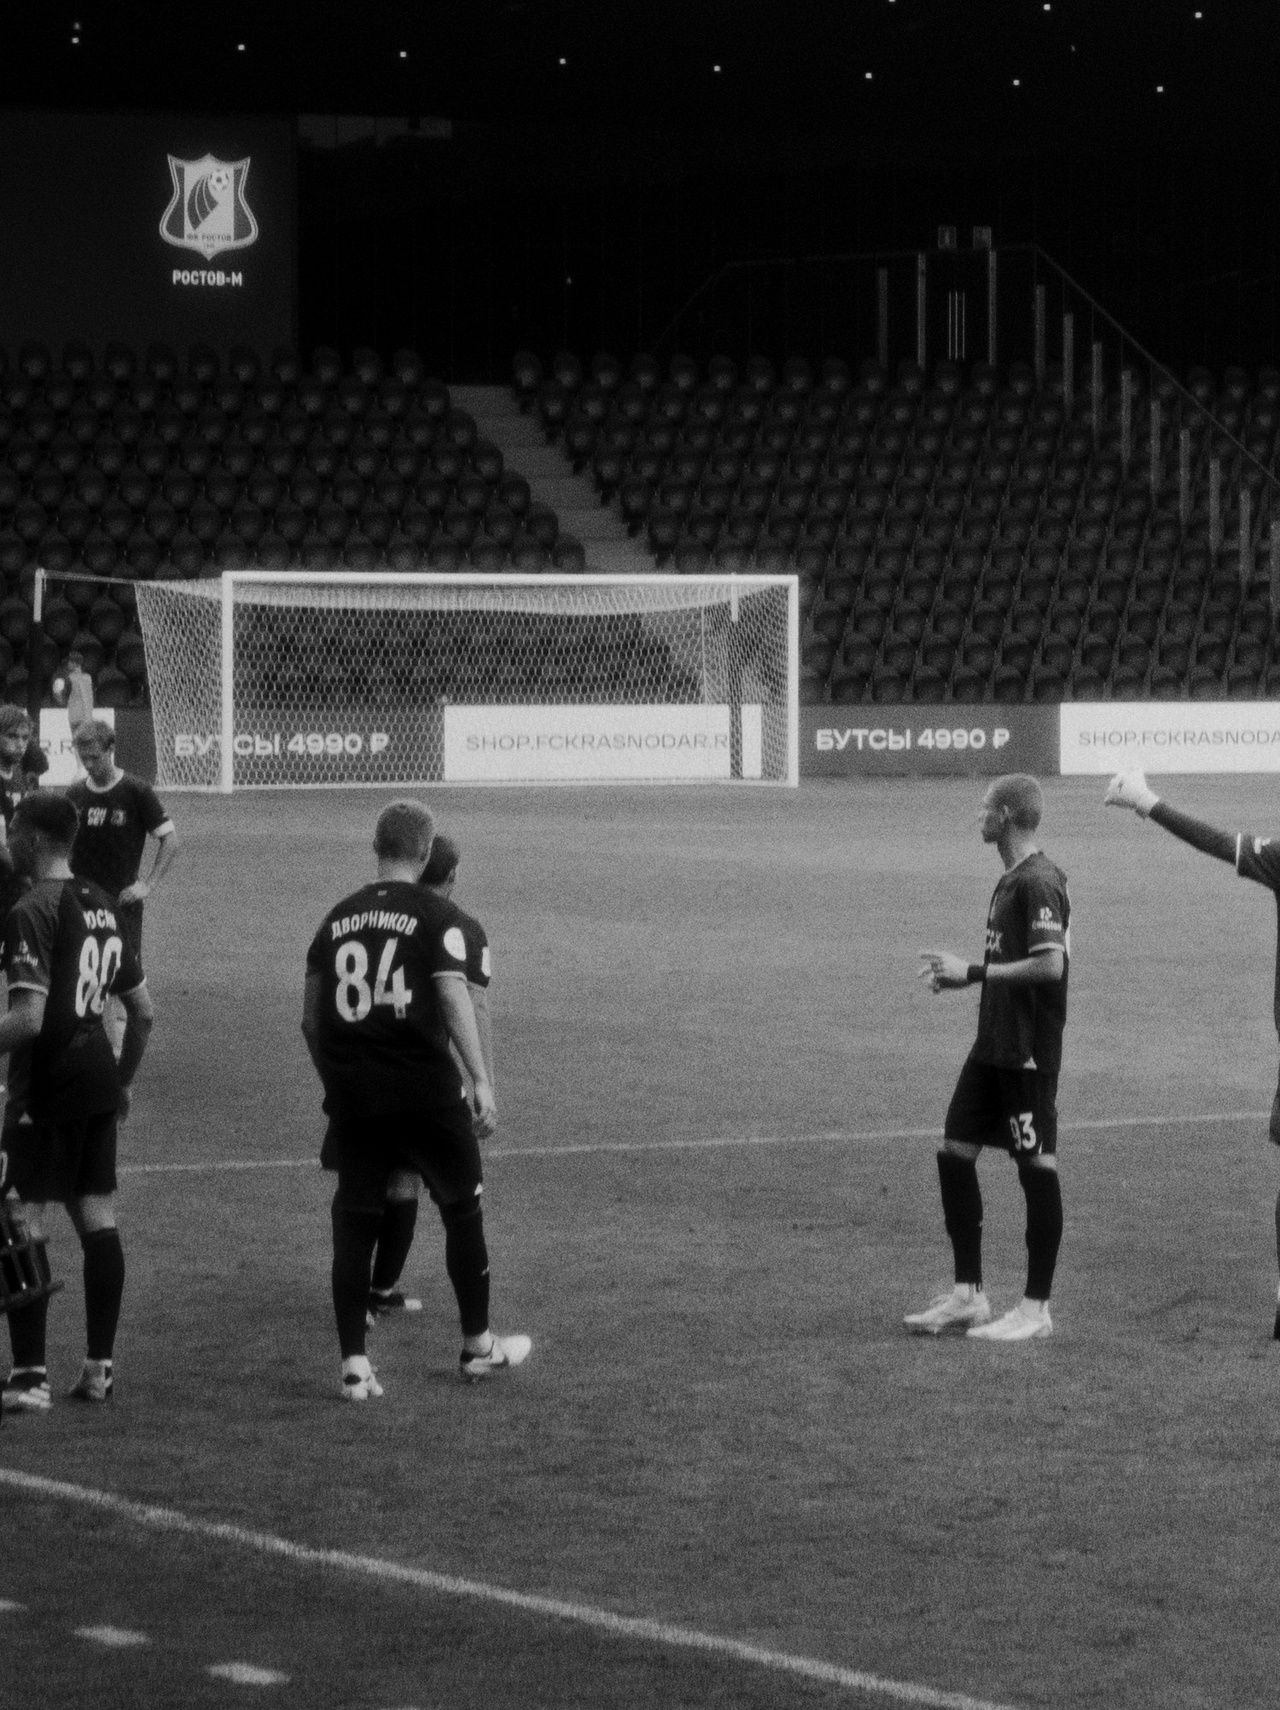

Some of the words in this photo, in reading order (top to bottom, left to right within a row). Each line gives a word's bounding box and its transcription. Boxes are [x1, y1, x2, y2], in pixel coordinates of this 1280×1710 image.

[172, 269, 243, 287] РОСТОВ-М
[287, 732, 362, 755] 4990
[466, 734, 729, 751] SHOP.FCKRASNODAR.R
[815, 728, 909, 751] БУТСЫ
[918, 728, 987, 750] 4990
[331, 909, 418, 942] ДВОРНИКОВ
[75, 935, 123, 1018] 80
[334, 936, 412, 1022] 84
[1010, 1111, 1037, 1152] 93
